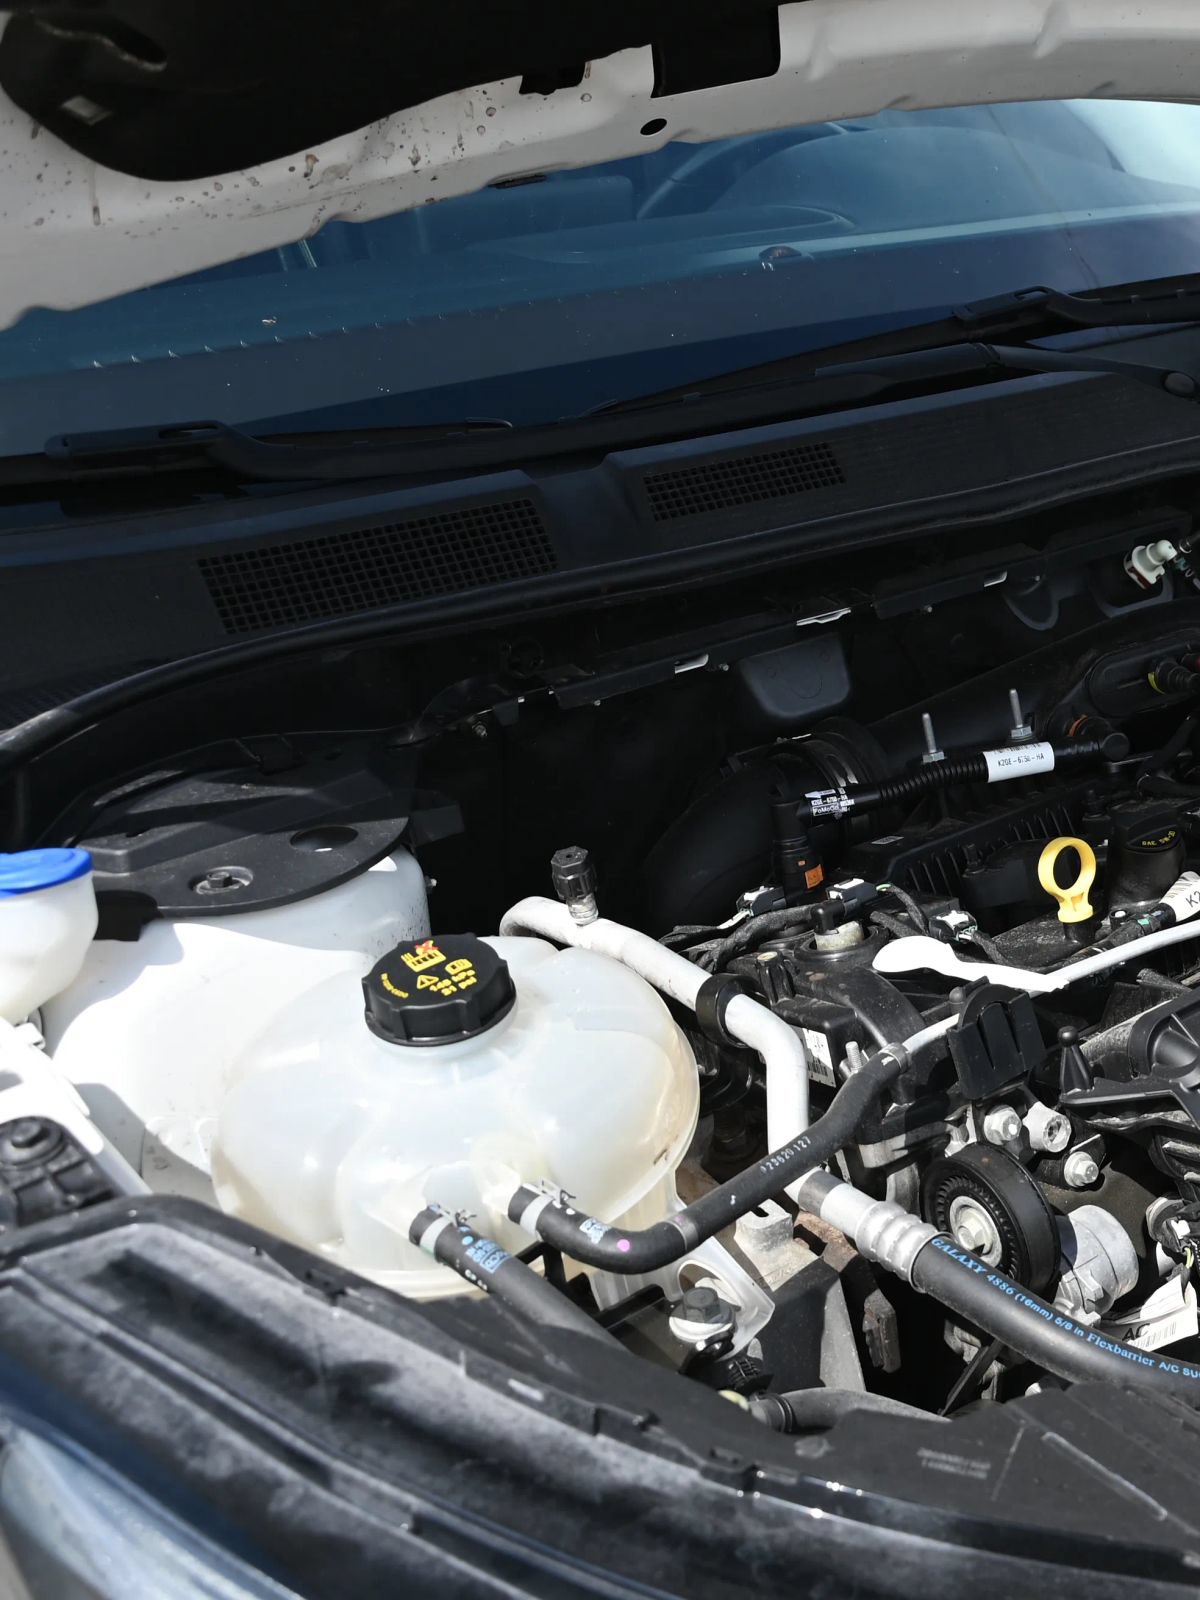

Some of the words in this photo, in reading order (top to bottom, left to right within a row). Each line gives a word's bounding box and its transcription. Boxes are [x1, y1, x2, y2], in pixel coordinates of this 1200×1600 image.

[931, 1238, 987, 1275] GALAXY
[986, 1274, 1016, 1296] 4886
[1014, 1293, 1055, 1322] (16mm)
[1054, 1316, 1074, 1332] 5/8
[1073, 1325, 1085, 1337] in
[1087, 1332, 1155, 1367] Flexbarrier
[1159, 1361, 1180, 1375] A/C
[1122, 1322, 1151, 1342] AC
